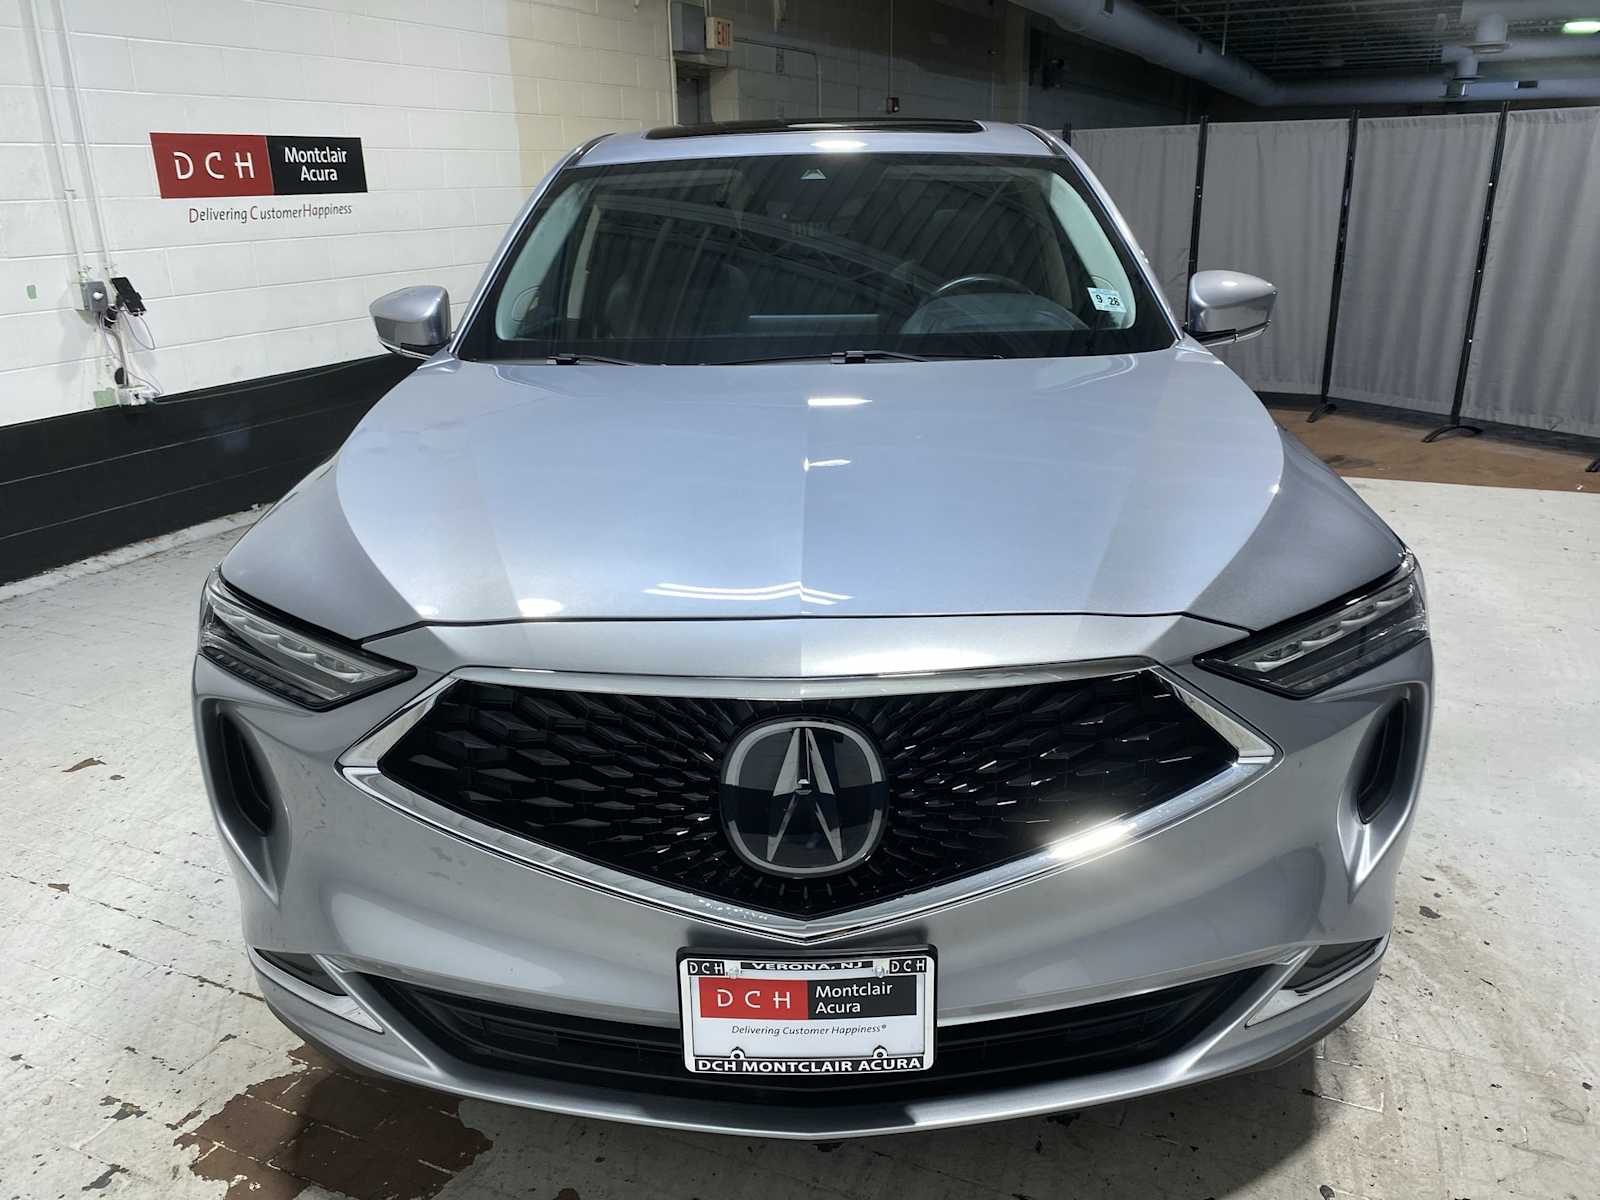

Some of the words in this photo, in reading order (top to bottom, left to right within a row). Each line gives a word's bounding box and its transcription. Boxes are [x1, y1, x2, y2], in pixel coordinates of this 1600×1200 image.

[284, 147, 347, 164] Montclair
[173, 151, 255, 180] DCH
[300, 166, 338, 182] Acura
[188, 207, 248, 224] Delivering
[250, 205, 302, 220] Customer
[302, 203, 352, 219] Happiness
[1095, 294, 1103, 303] 9
[689, 962, 725, 975] DCH
[840, 962, 863, 970] NJ
[890, 960, 926, 972] DCH
[815, 982, 893, 999] Montclair
[716, 988, 791, 1010] DCH
[815, 1001, 861, 1015] Acura
[731, 1025, 780, 1037] Delivering
[782, 1026, 830, 1036] Customer
[698, 1060, 737, 1072] DCH
[742, 1060, 853, 1073] MONTCLAIR
[857, 1057, 922, 1072] ACURA
